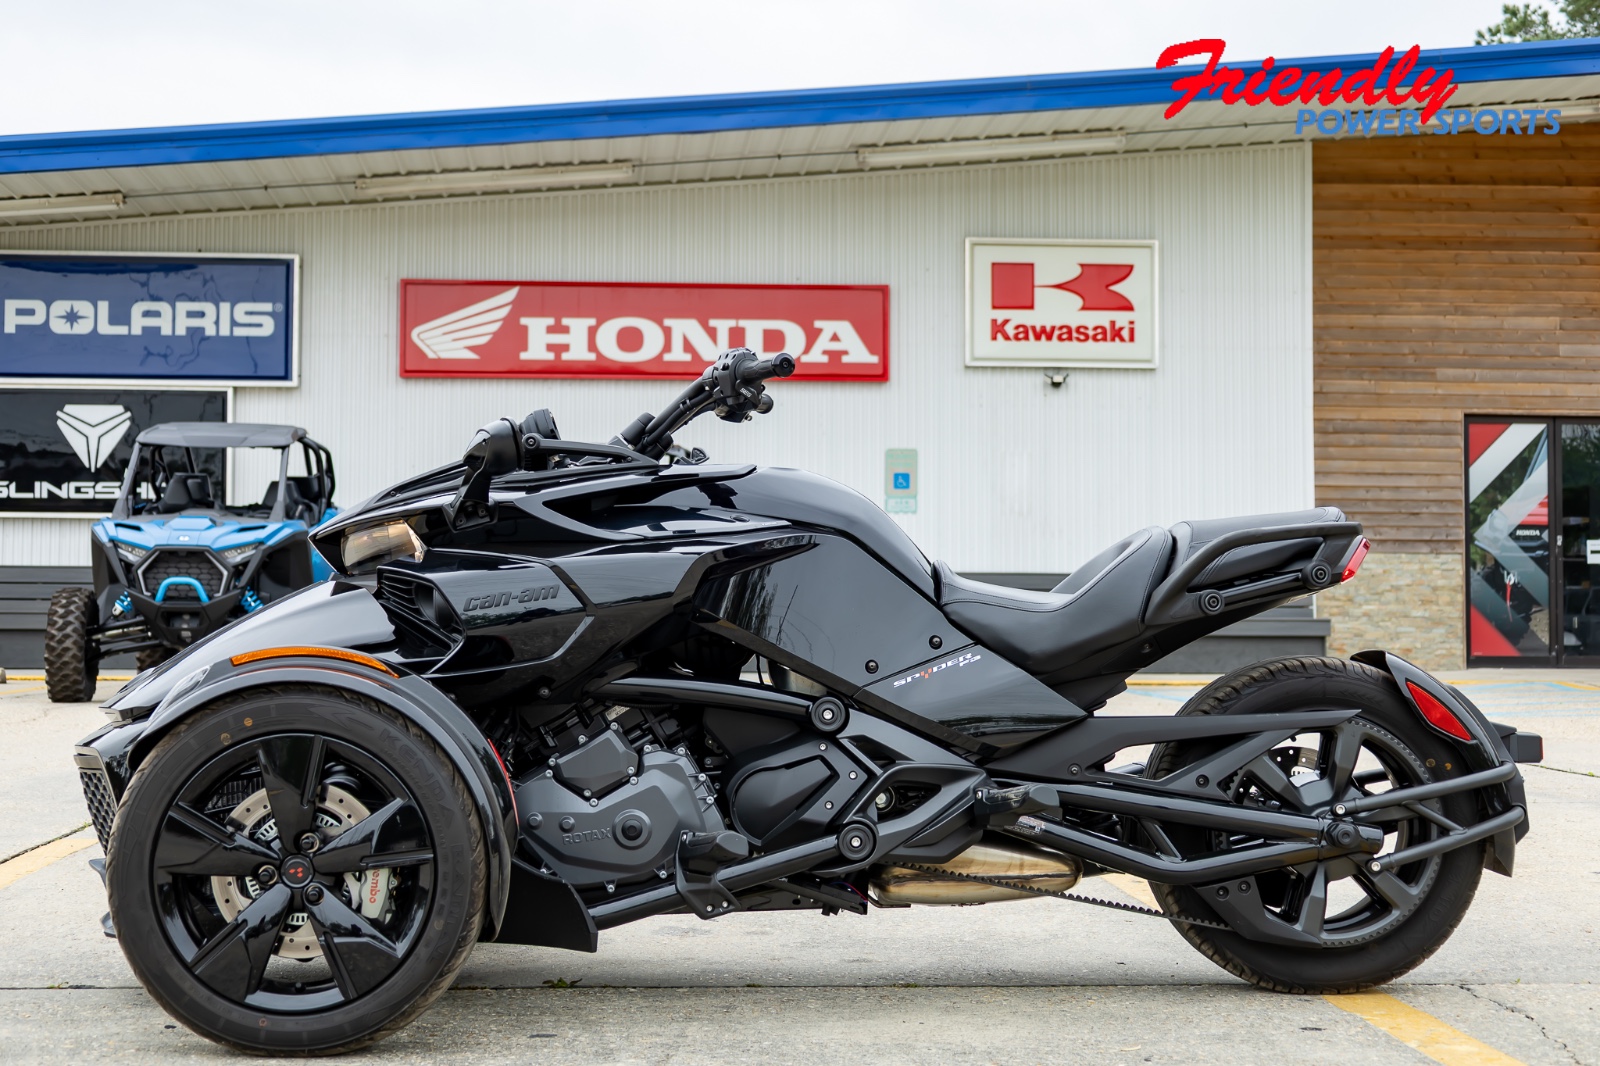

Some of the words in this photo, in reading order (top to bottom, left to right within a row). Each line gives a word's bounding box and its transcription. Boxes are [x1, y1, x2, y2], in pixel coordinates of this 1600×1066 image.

[519, 316, 879, 364] HONDA
[990, 318, 1136, 343] Kawasaki
[562, 827, 611, 845] ROTAX
